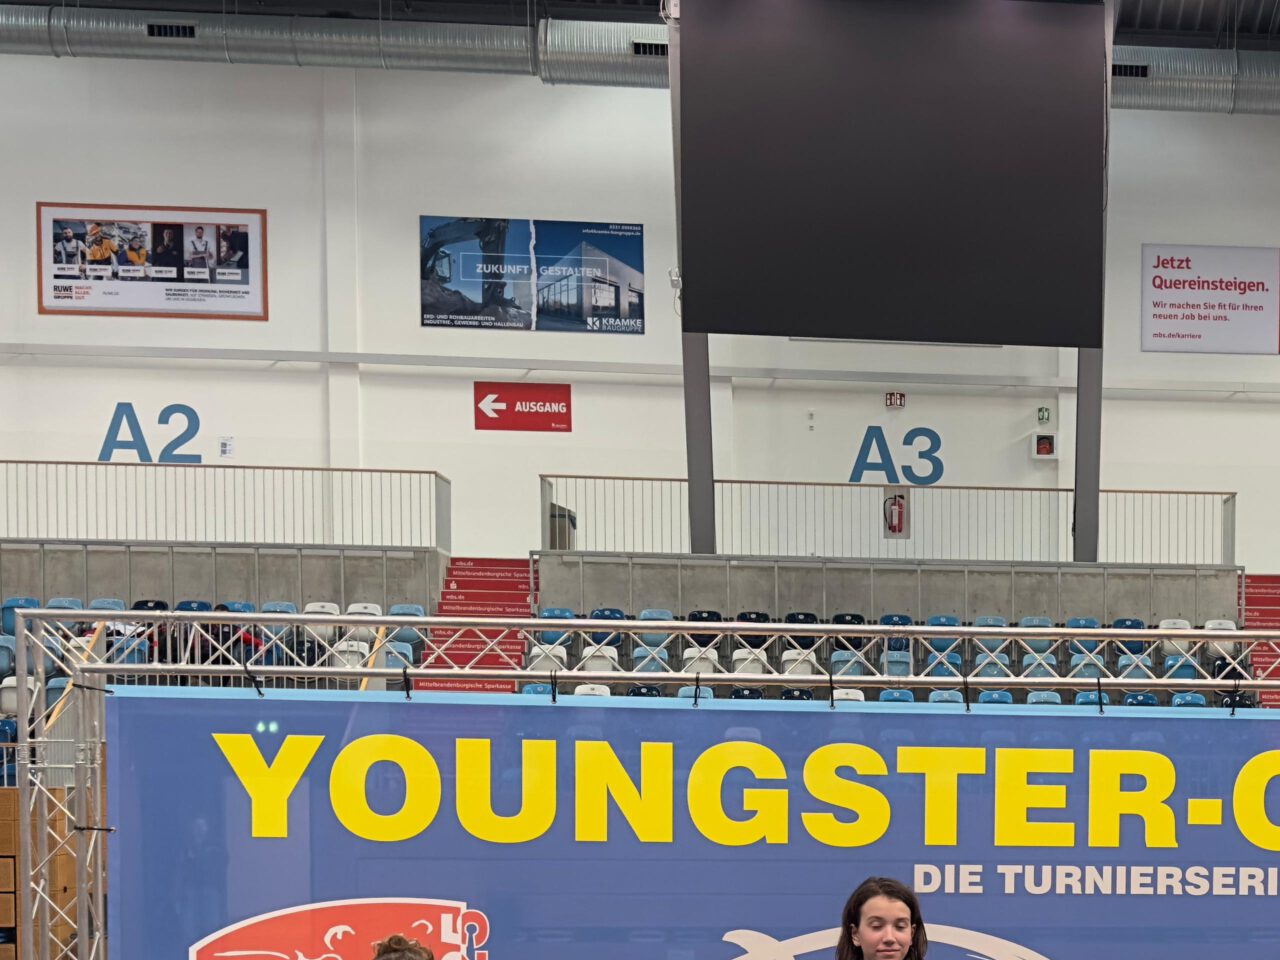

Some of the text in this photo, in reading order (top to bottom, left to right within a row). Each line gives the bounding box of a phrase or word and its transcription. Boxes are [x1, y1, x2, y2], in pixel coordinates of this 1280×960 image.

[1152, 255, 1192, 270] Jetzt
[476, 264, 601, 277] ZUKUNFT GESTALTEN
[53, 285, 73, 293] RUWE
[1152, 275, 1269, 295] Quereinsteigen.
[1152, 301, 1264, 311] Wir machen Sie fit für Ihren
[602, 317, 642, 327] KRAMKE
[1197, 313, 1211, 321] bei
[1152, 332, 1202, 340] mbs.de/karriere
[514, 401, 567, 413] AUSGANG
[98, 402, 202, 463] A2
[848, 425, 944, 486] A3
[419, 681, 483, 689] Mittelbrandenburgische
[913, 864, 983, 892] DIE
